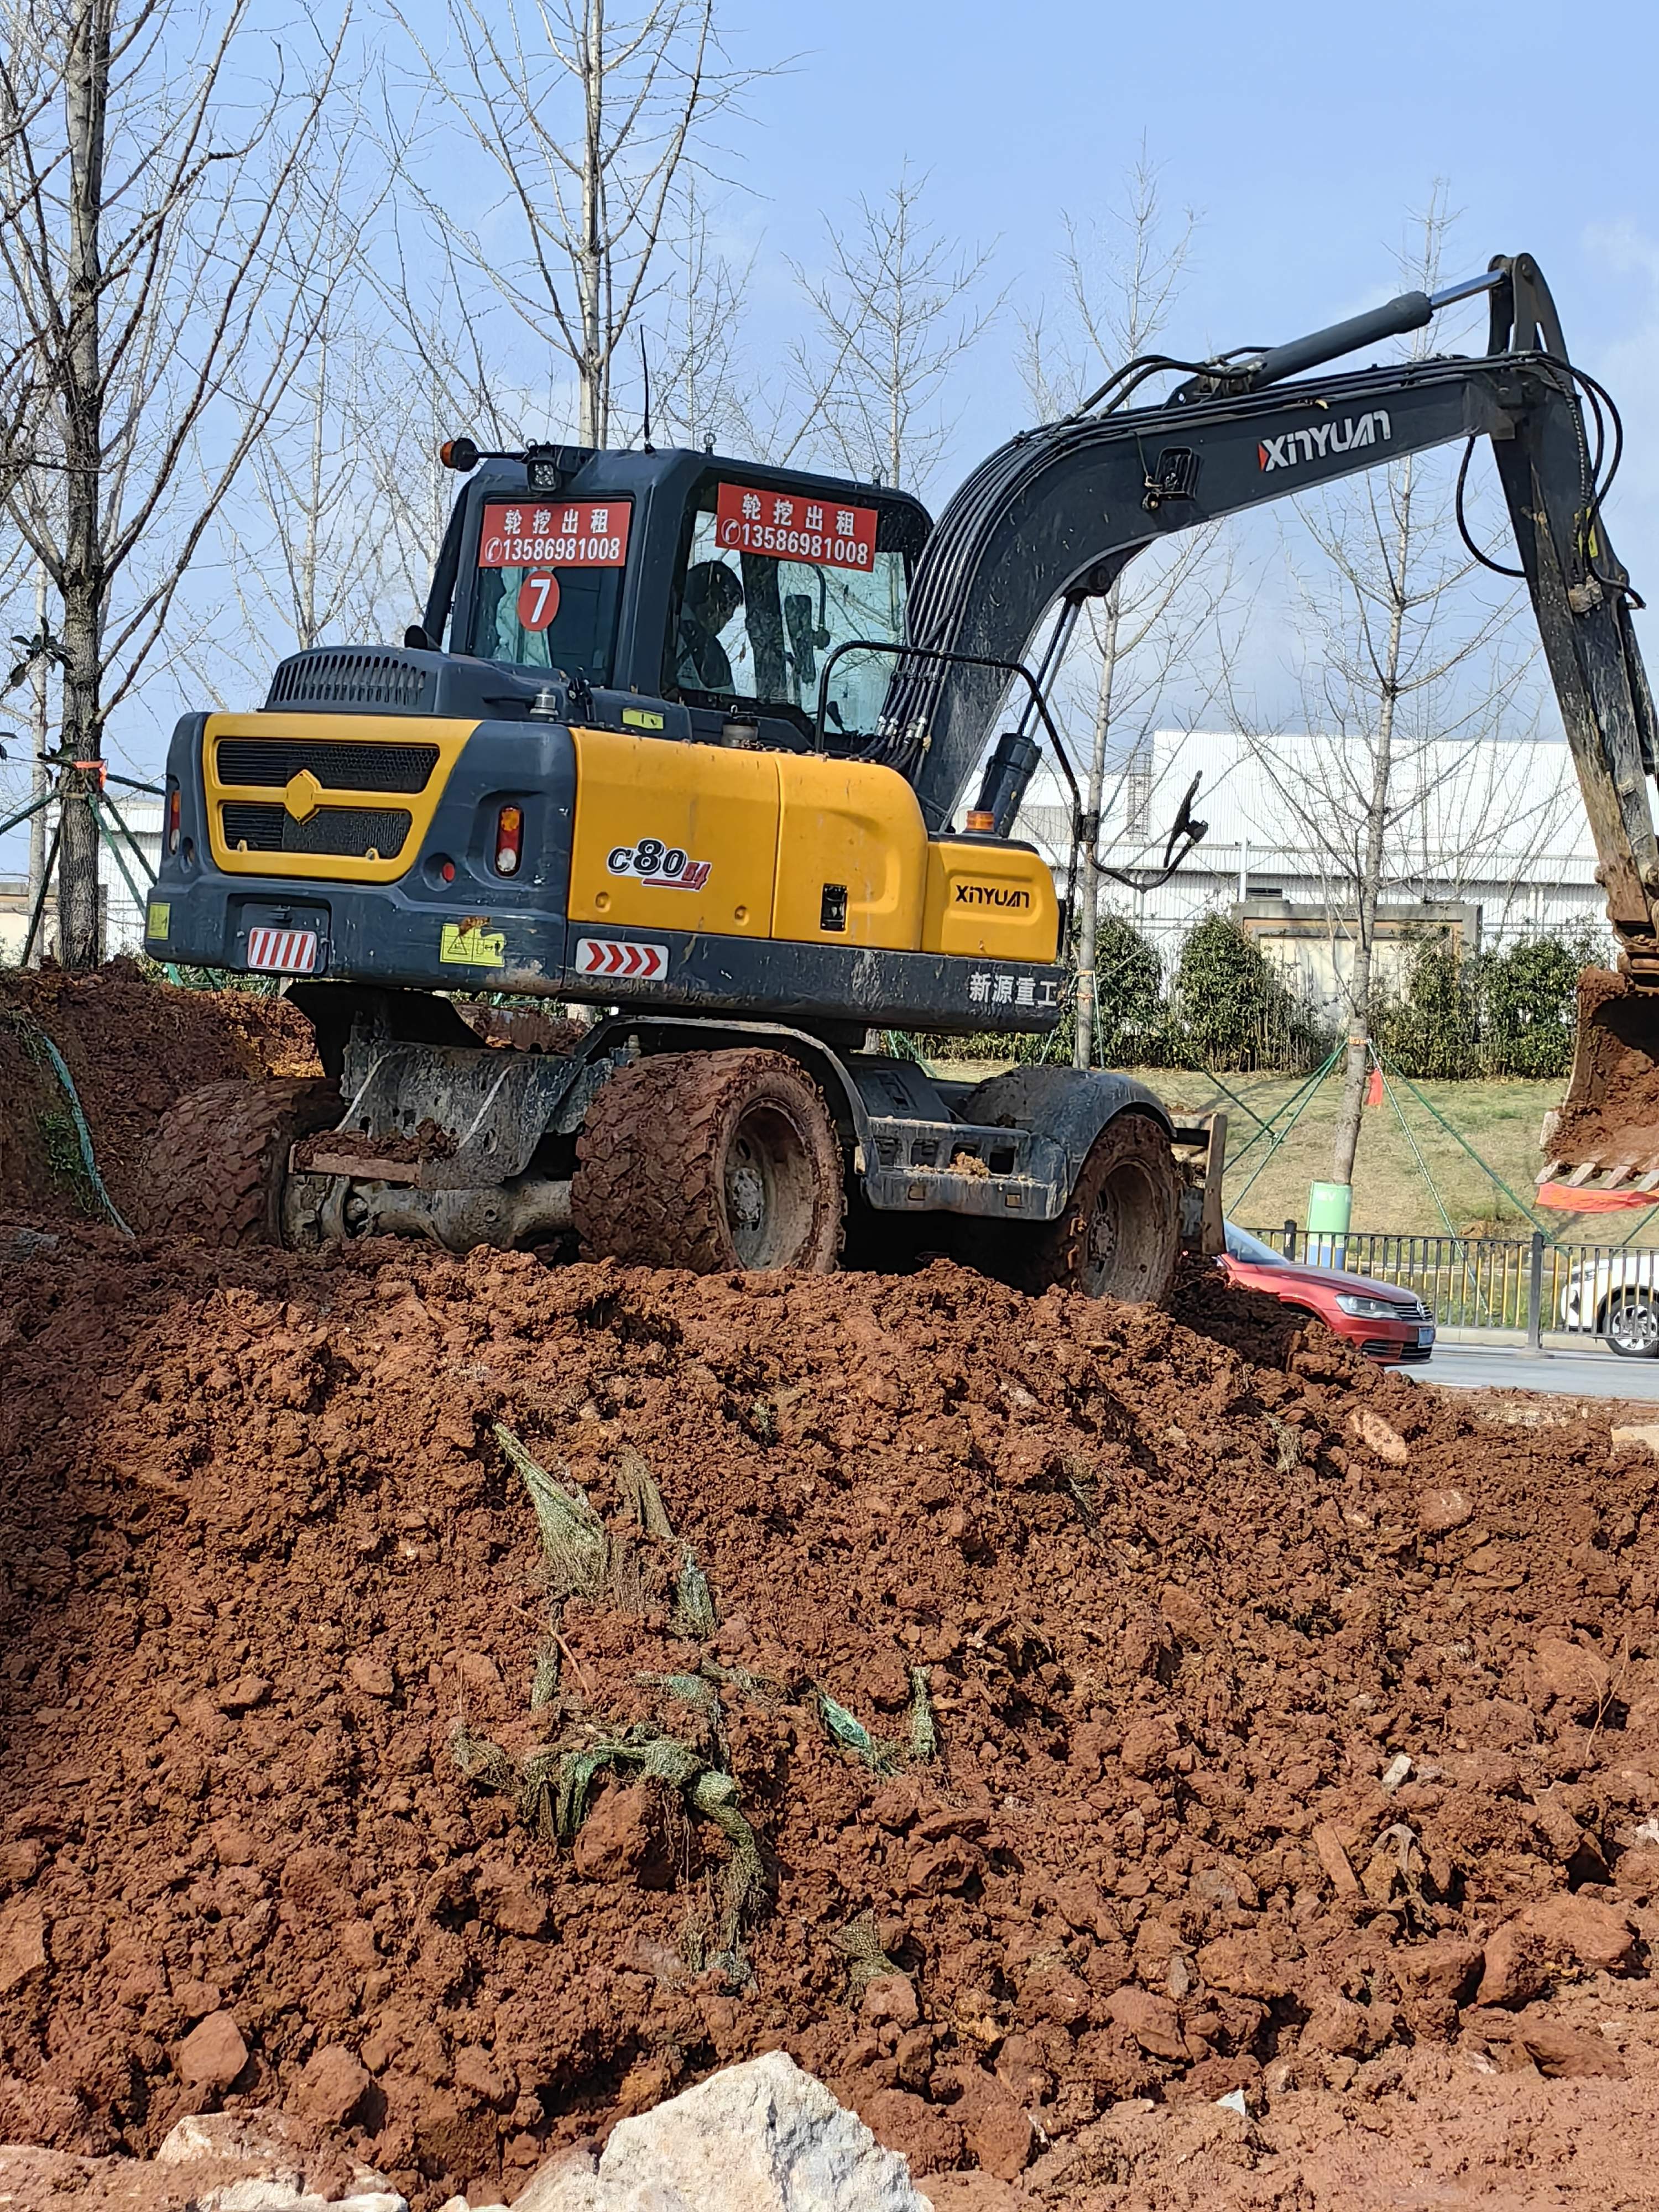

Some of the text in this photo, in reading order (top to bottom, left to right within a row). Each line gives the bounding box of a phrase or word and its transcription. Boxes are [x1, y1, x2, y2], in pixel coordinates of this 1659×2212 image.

[504, 508, 608, 535] 轮挖出租
[741, 493, 854, 536] 轮挖出租
[503, 538, 620, 560] 13586981008
[742, 523, 868, 565] 13586981008
[530, 579, 551, 623] 7
[969, 972, 1057, 1006] 新源重工
